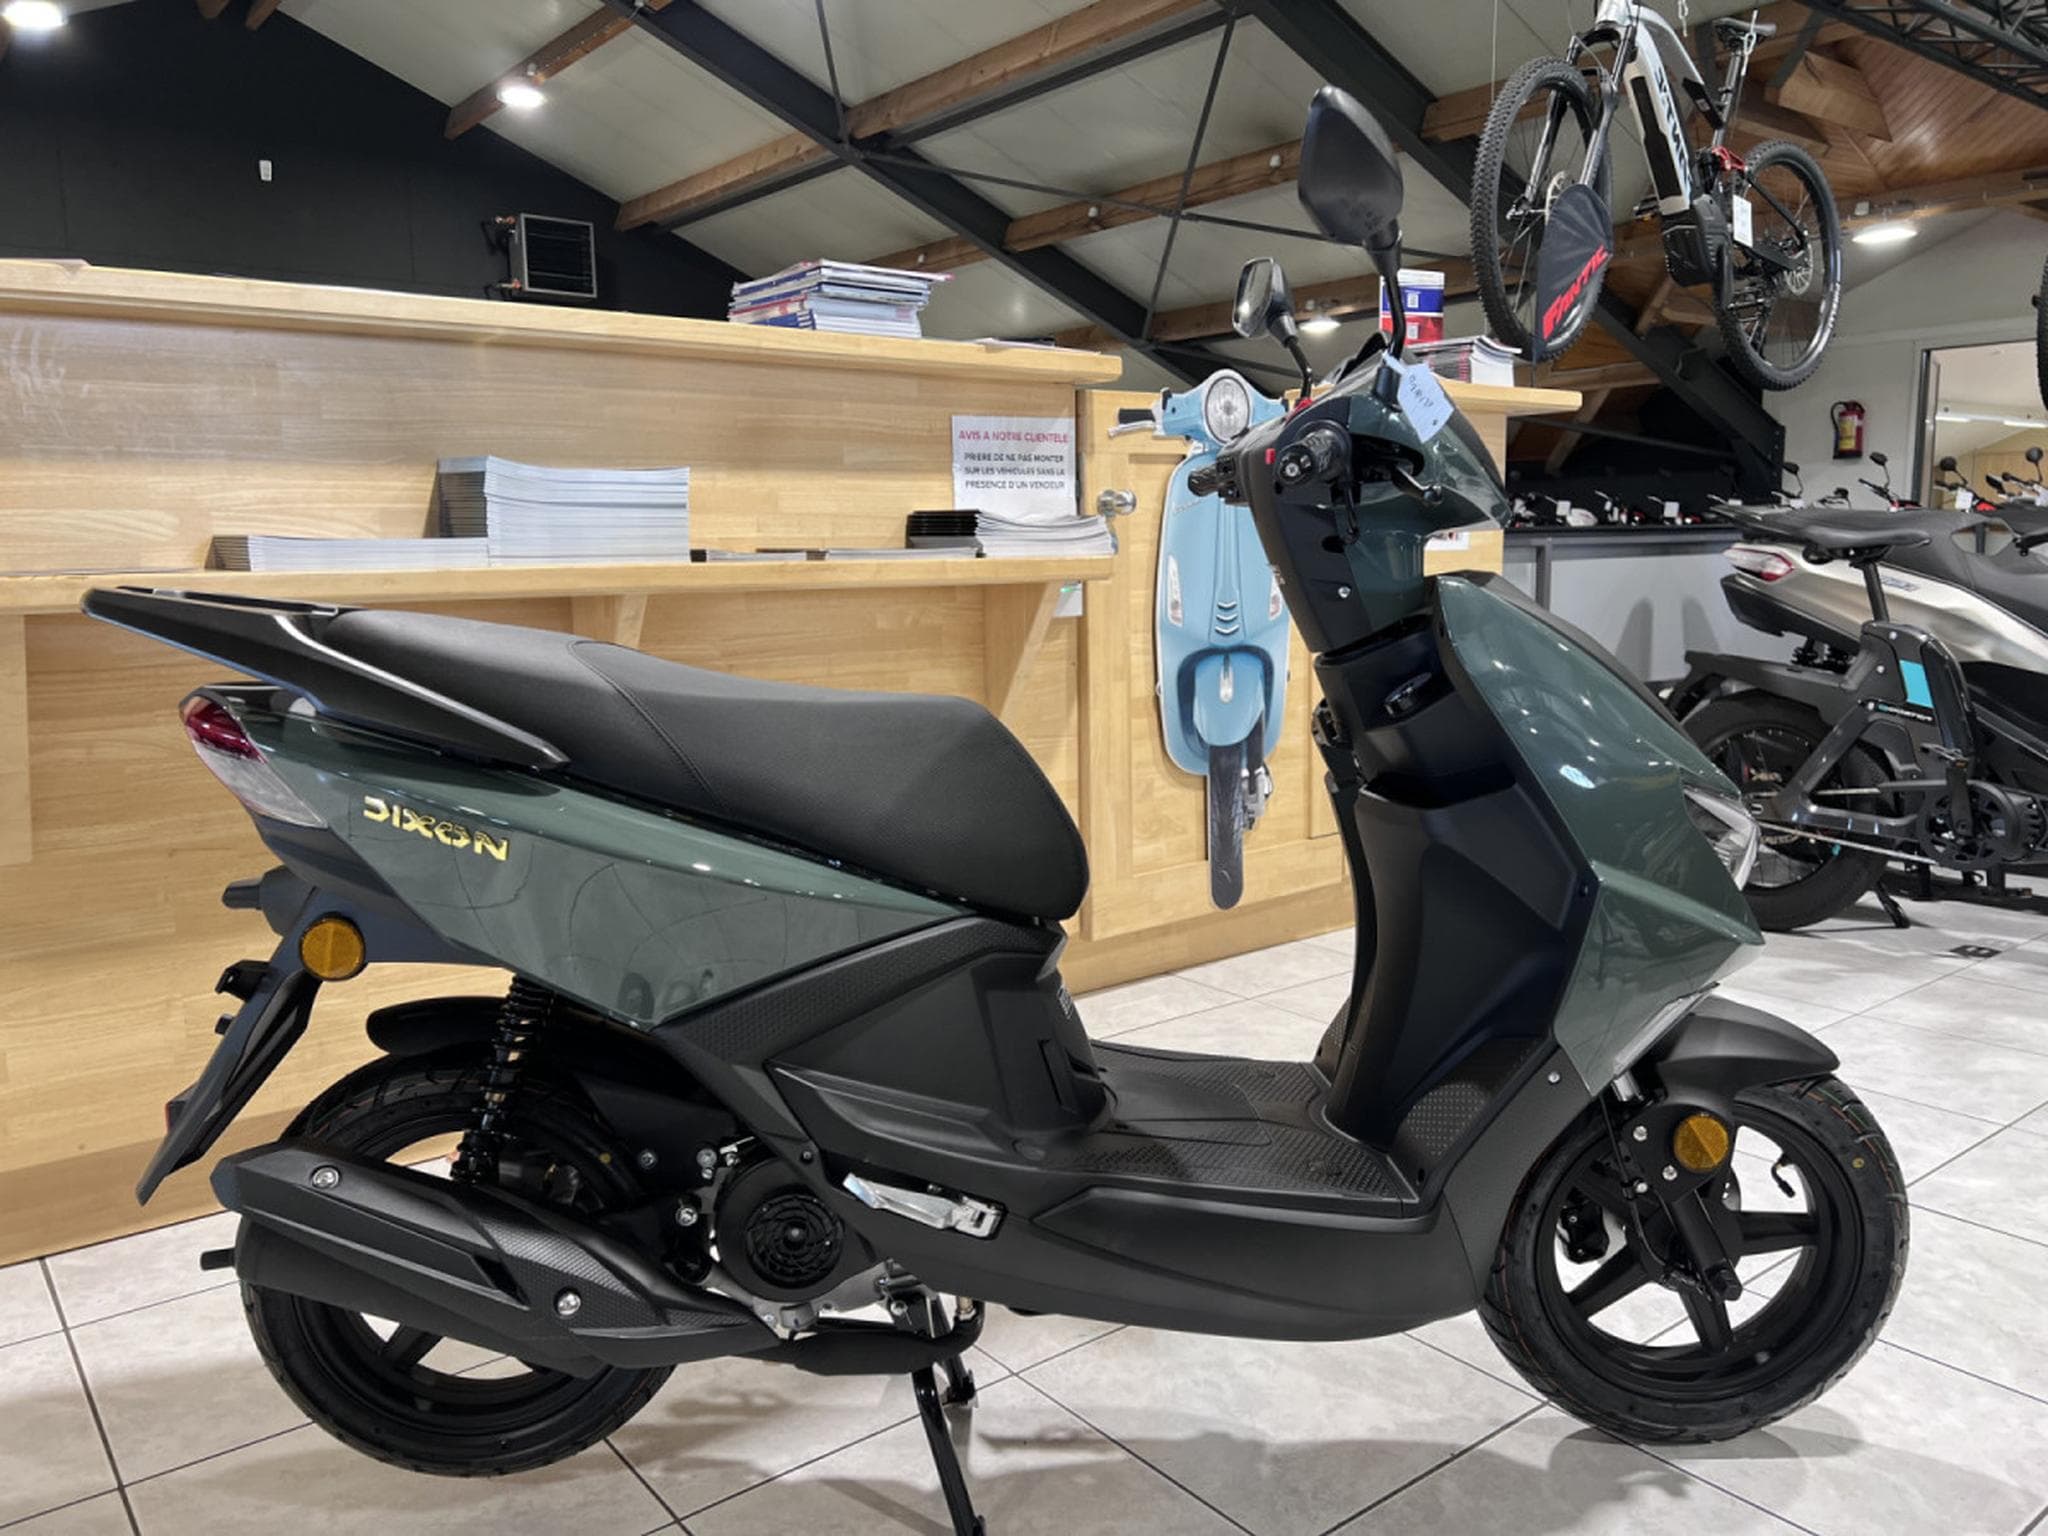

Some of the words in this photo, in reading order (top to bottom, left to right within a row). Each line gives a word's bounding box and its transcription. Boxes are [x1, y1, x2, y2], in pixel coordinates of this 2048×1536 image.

[958, 430, 981, 441] AVIS
[992, 430, 1022, 441] NOTRE
[993, 453, 1004, 462] DE
[1005, 453, 1015, 462] NE
[1017, 453, 1032, 462] PAS
[1034, 454, 1064, 463] MONTER
[964, 466, 980, 475] SUR
[982, 467, 995, 475] LES
[1037, 467, 1055, 476] SANS
[1056, 468, 1065, 476] LA
[1008, 480, 1028, 489] D'UN
[1029, 480, 1065, 489] VENDEUR
